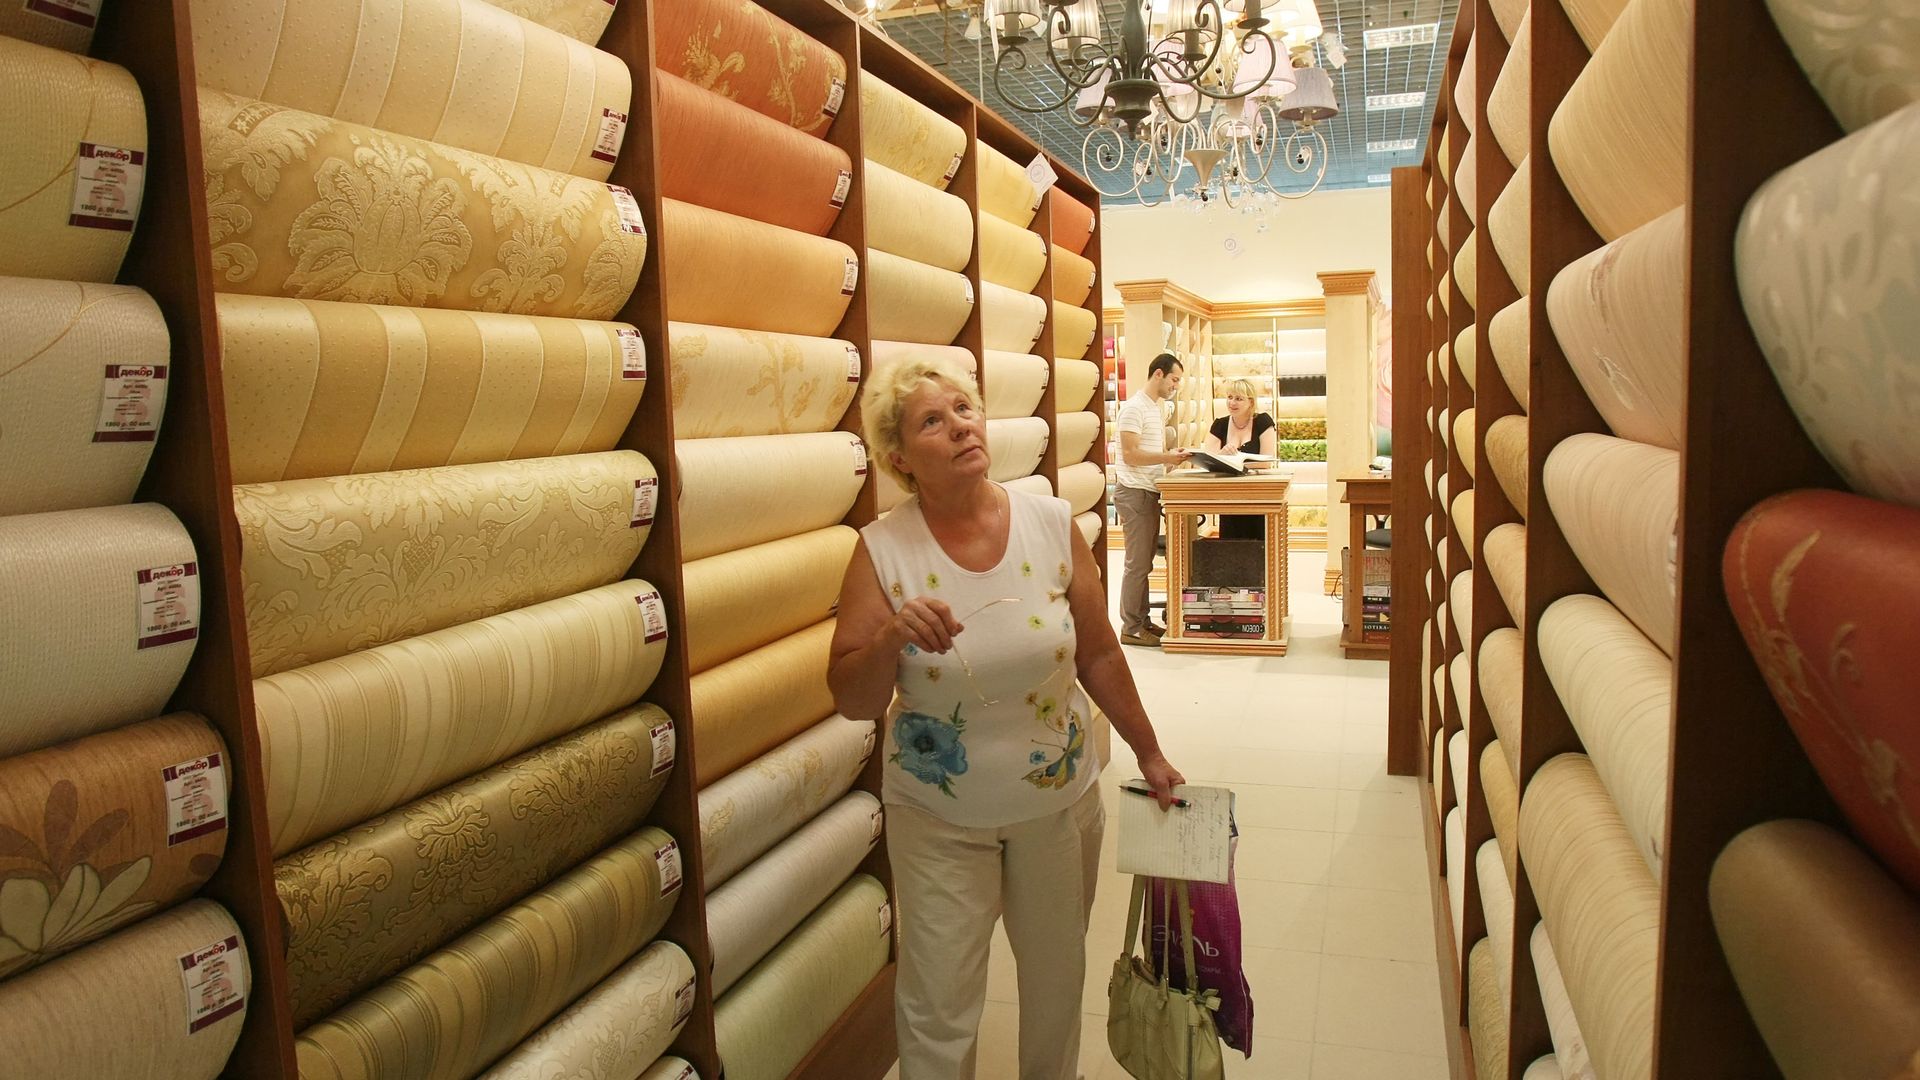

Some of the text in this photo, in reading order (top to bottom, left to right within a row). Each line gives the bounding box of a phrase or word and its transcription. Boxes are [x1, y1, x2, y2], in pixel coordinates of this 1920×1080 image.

[96, 149, 130, 161] декор
[121, 366, 153, 377] декор
[153, 566, 183, 580] декор
[178, 760, 208, 776] декор
